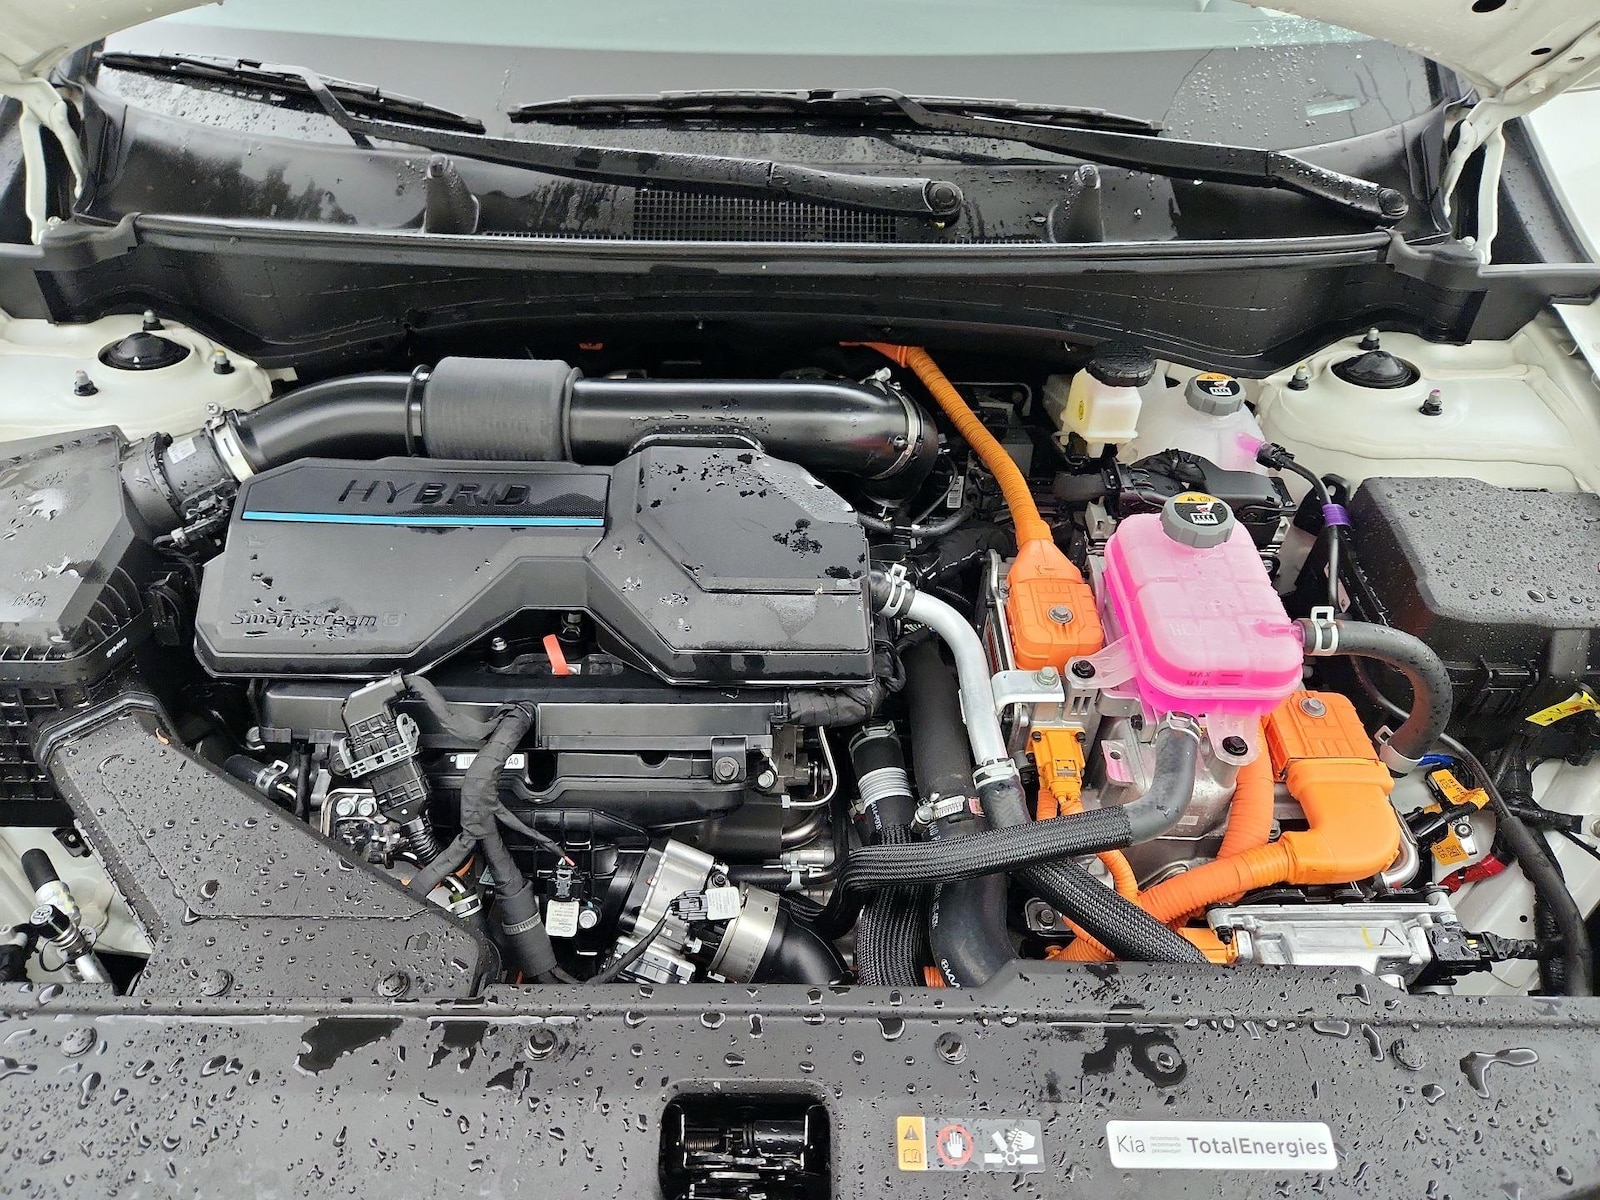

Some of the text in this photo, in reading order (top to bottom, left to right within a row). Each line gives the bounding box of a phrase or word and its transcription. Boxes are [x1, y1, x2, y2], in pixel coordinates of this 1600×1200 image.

[337, 479, 532, 507] HYBRID
[230, 610, 377, 628] Smartstream
[1116, 1135, 1146, 1153] Kia
[1186, 1136, 1328, 1158] TotalEnergies
